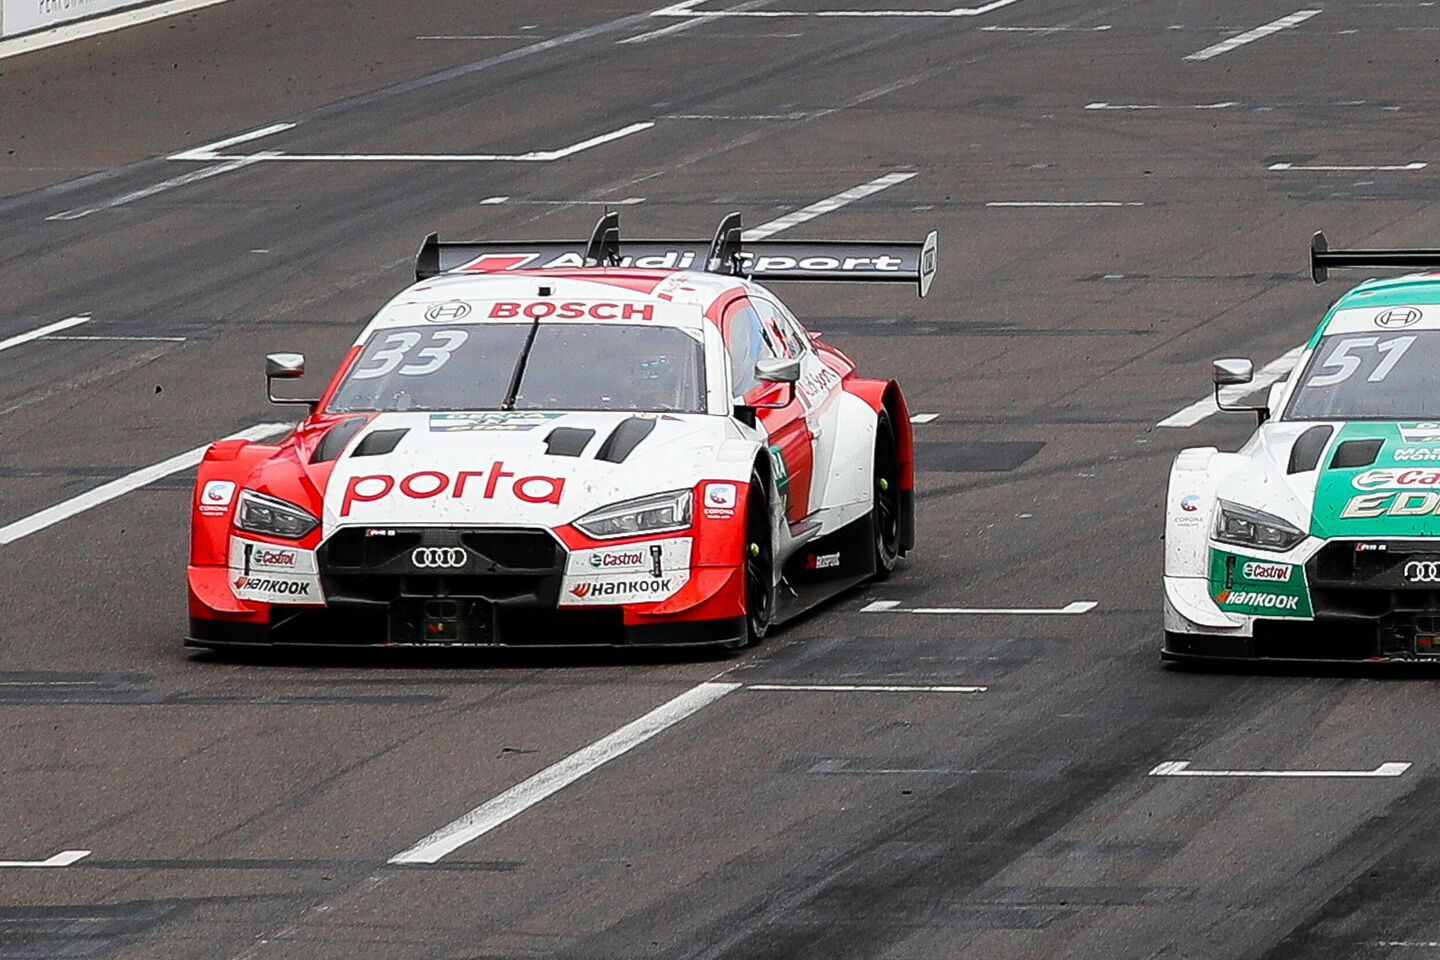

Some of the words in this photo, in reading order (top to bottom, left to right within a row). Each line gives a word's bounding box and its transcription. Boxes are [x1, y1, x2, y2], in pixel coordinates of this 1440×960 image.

[488, 302, 654, 321] BOSCH
[352, 330, 470, 380] 33
[1307, 335, 1418, 387] 51
[340, 461, 566, 517] porta
[262, 550, 295, 565] Castrol
[602, 552, 643, 566] Castrol
[1253, 564, 1288, 580] Castrol
